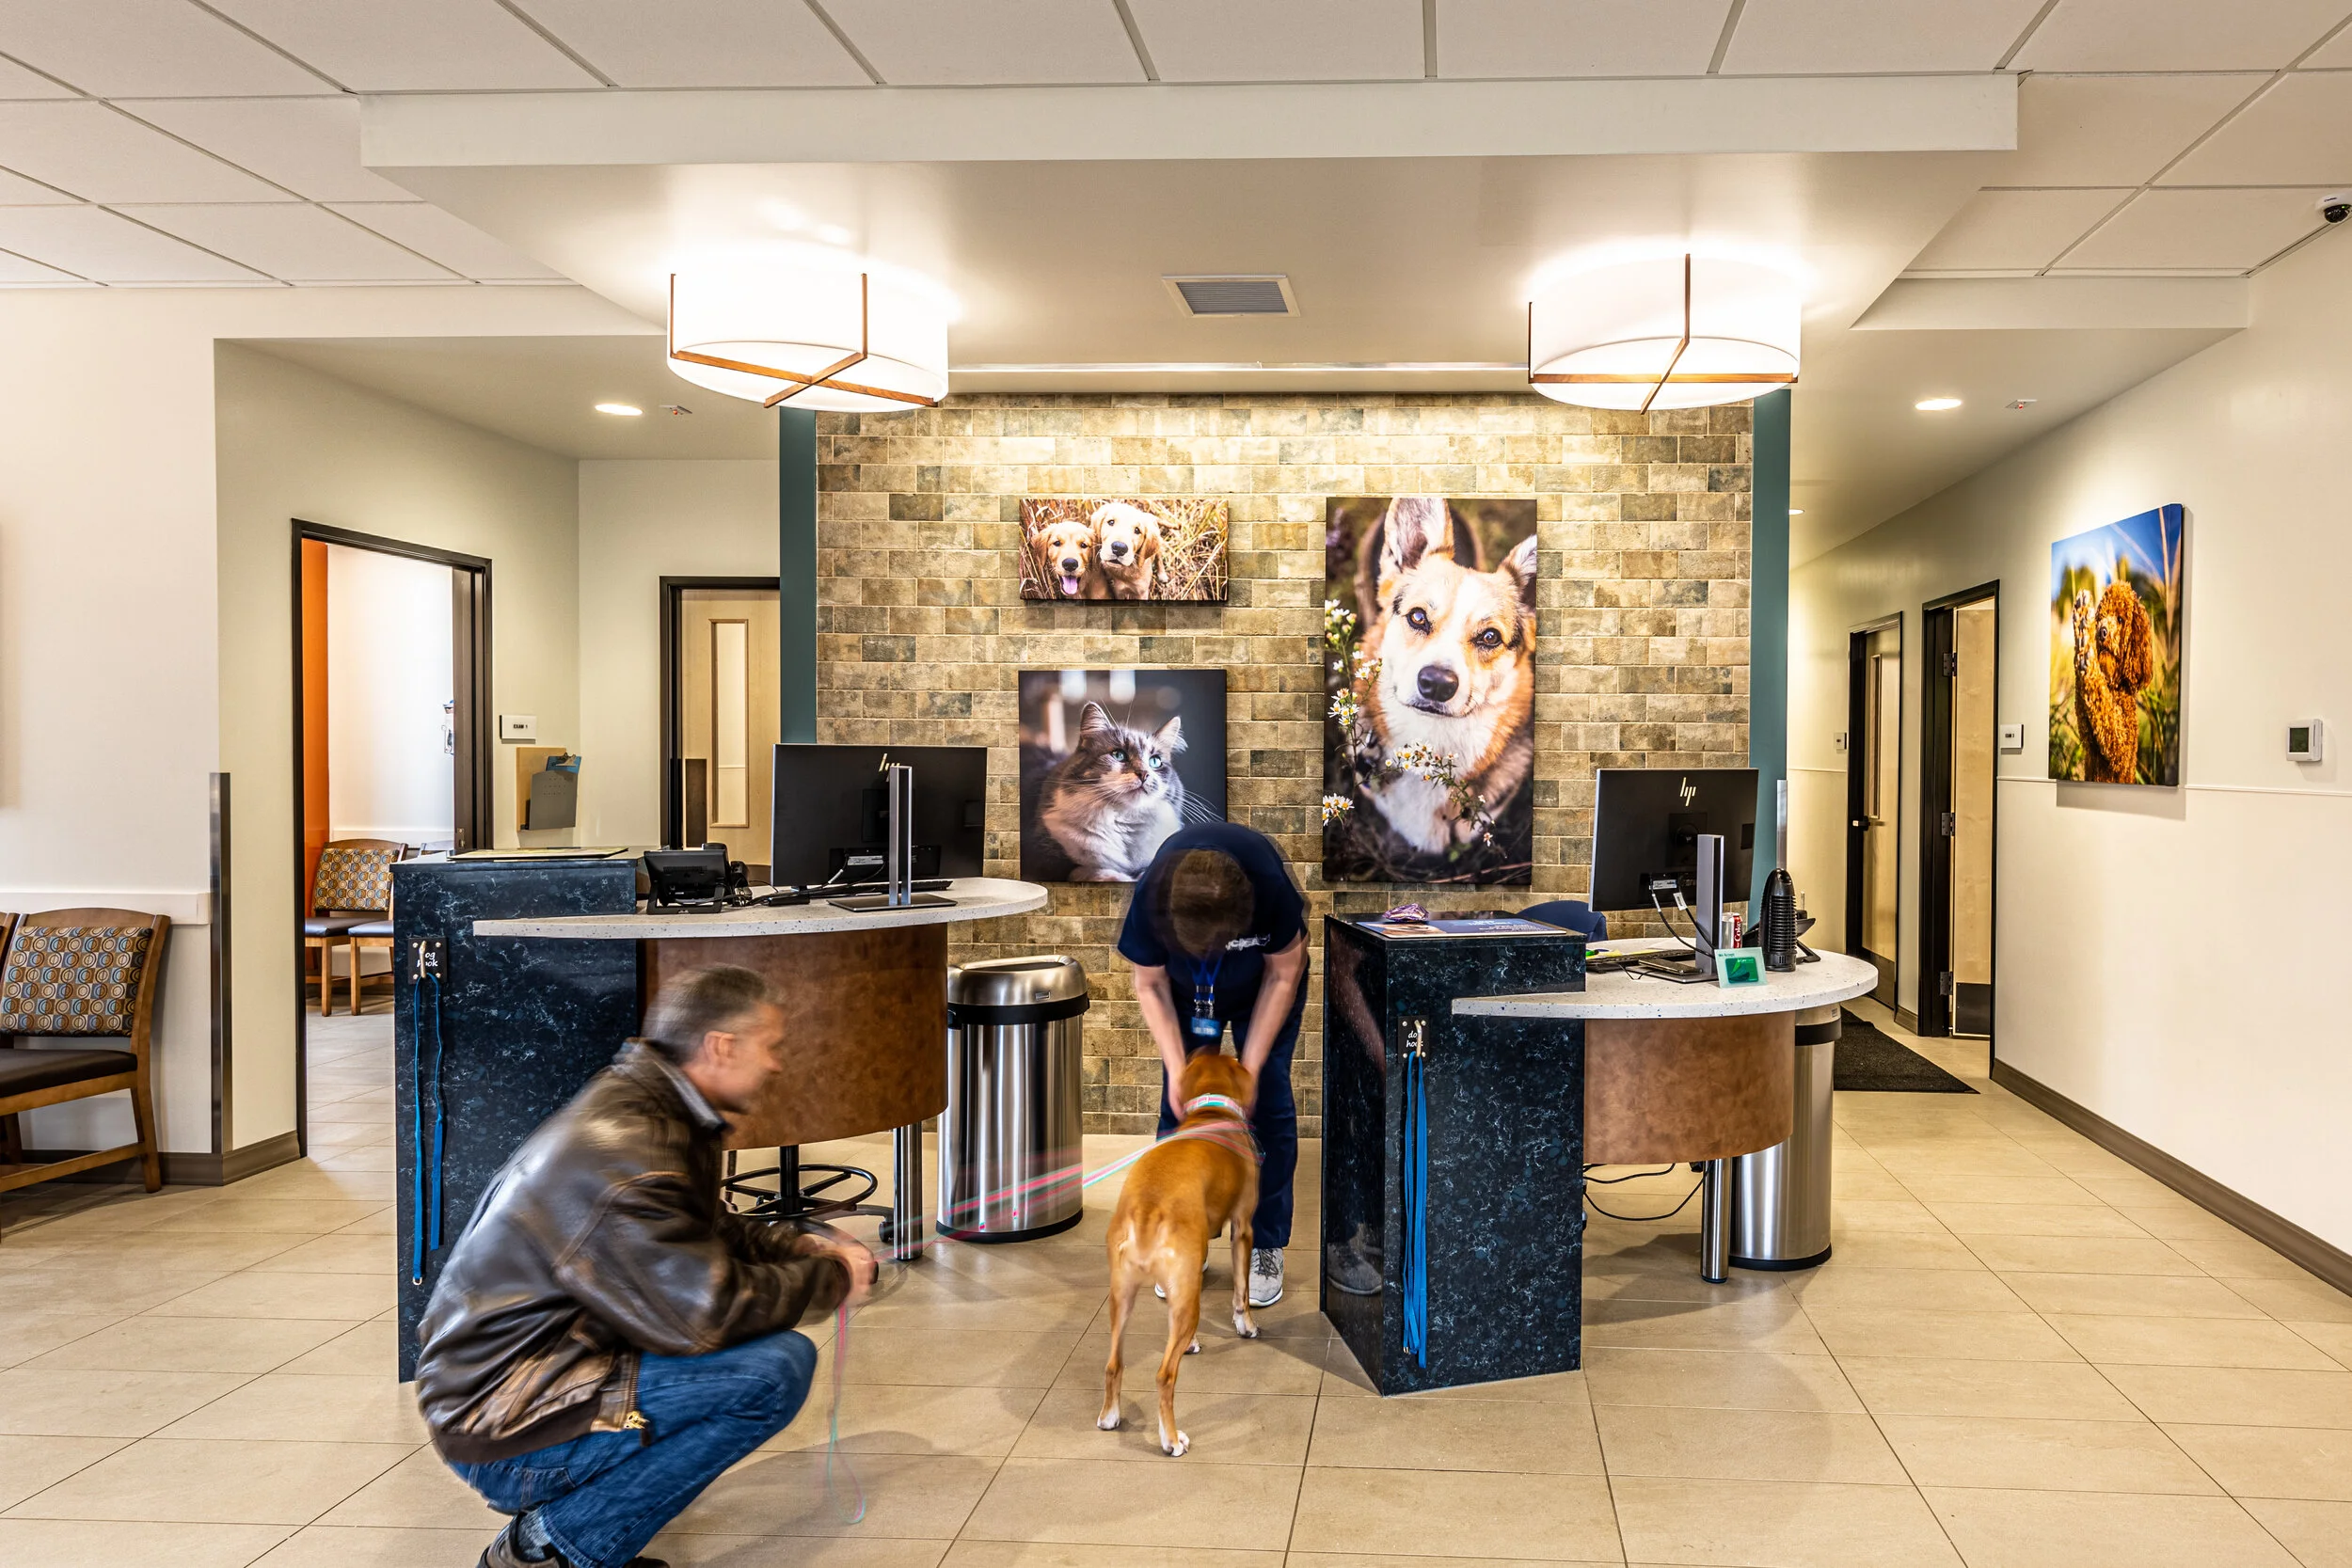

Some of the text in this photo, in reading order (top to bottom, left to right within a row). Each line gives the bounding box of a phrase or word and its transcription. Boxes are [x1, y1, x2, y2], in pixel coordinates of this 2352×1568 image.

[1679, 777, 1696, 806] hp
[1407, 1030, 1419, 1039] do
[1406, 1039, 1423, 1048] ho
